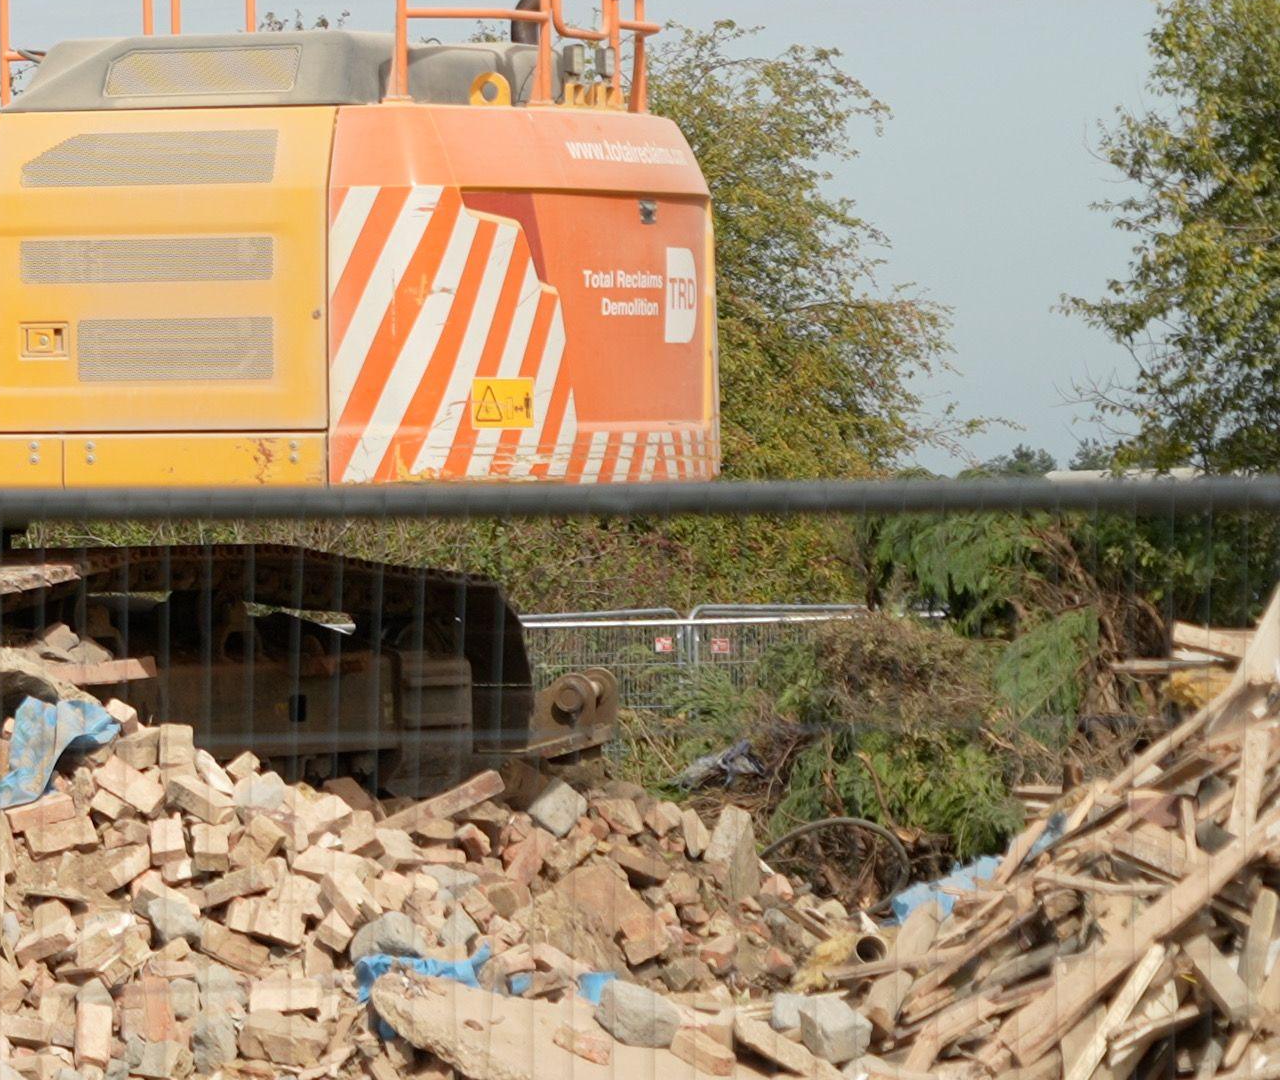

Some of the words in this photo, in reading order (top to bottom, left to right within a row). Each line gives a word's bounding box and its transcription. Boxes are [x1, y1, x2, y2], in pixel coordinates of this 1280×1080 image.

[582, 269, 614, 288] Total
[616, 270, 664, 289] Reclaims
[669, 277, 696, 310] TRD
[601, 297, 659, 315] Demolition
